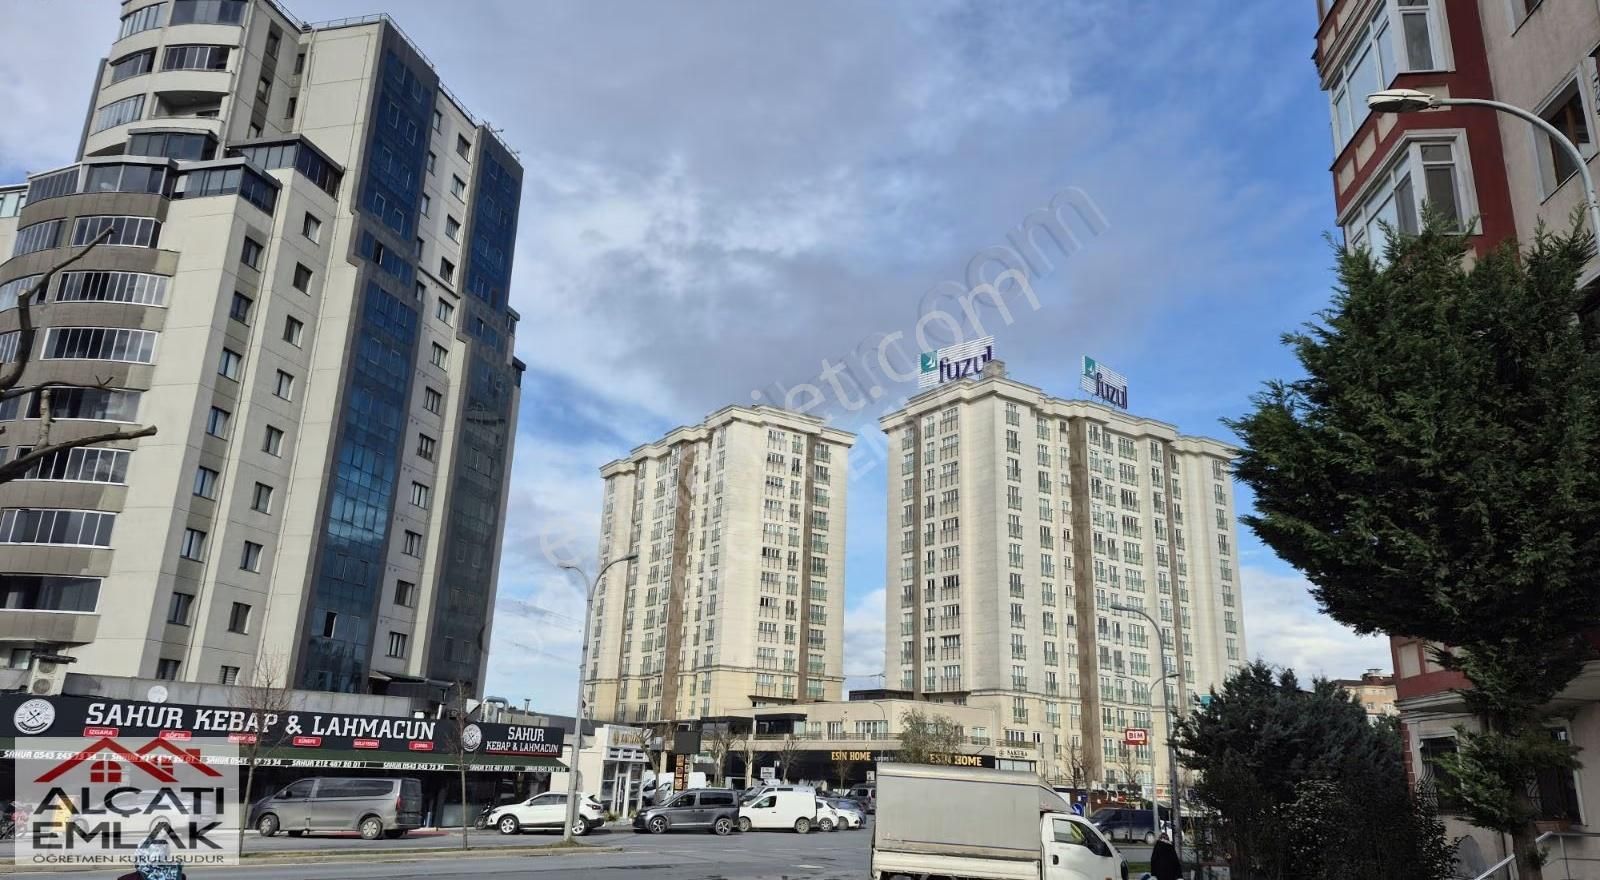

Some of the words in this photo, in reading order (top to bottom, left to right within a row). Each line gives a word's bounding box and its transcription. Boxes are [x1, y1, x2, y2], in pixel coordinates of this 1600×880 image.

[939, 345, 993, 384] fuzul
[1095, 371, 1128, 410] fuzul
[85, 702, 184, 729] SAHUR
[193, 708, 279, 734] KEBAP
[285, 714, 303, 736] &
[311, 715, 436, 741] LAHMACUN
[507, 726, 545, 742] SAHUR
[486, 740, 511, 751] KEBAP
[512, 743, 518, 751] &
[519, 742, 559, 753] LAHMACUN
[4, 750, 32, 758] SAHUR
[34, 751, 54, 759] 0543
[849, 751, 872, 761] HOME
[954, 755, 983, 767] HOME
[292, 759, 314, 767] SAHUR
